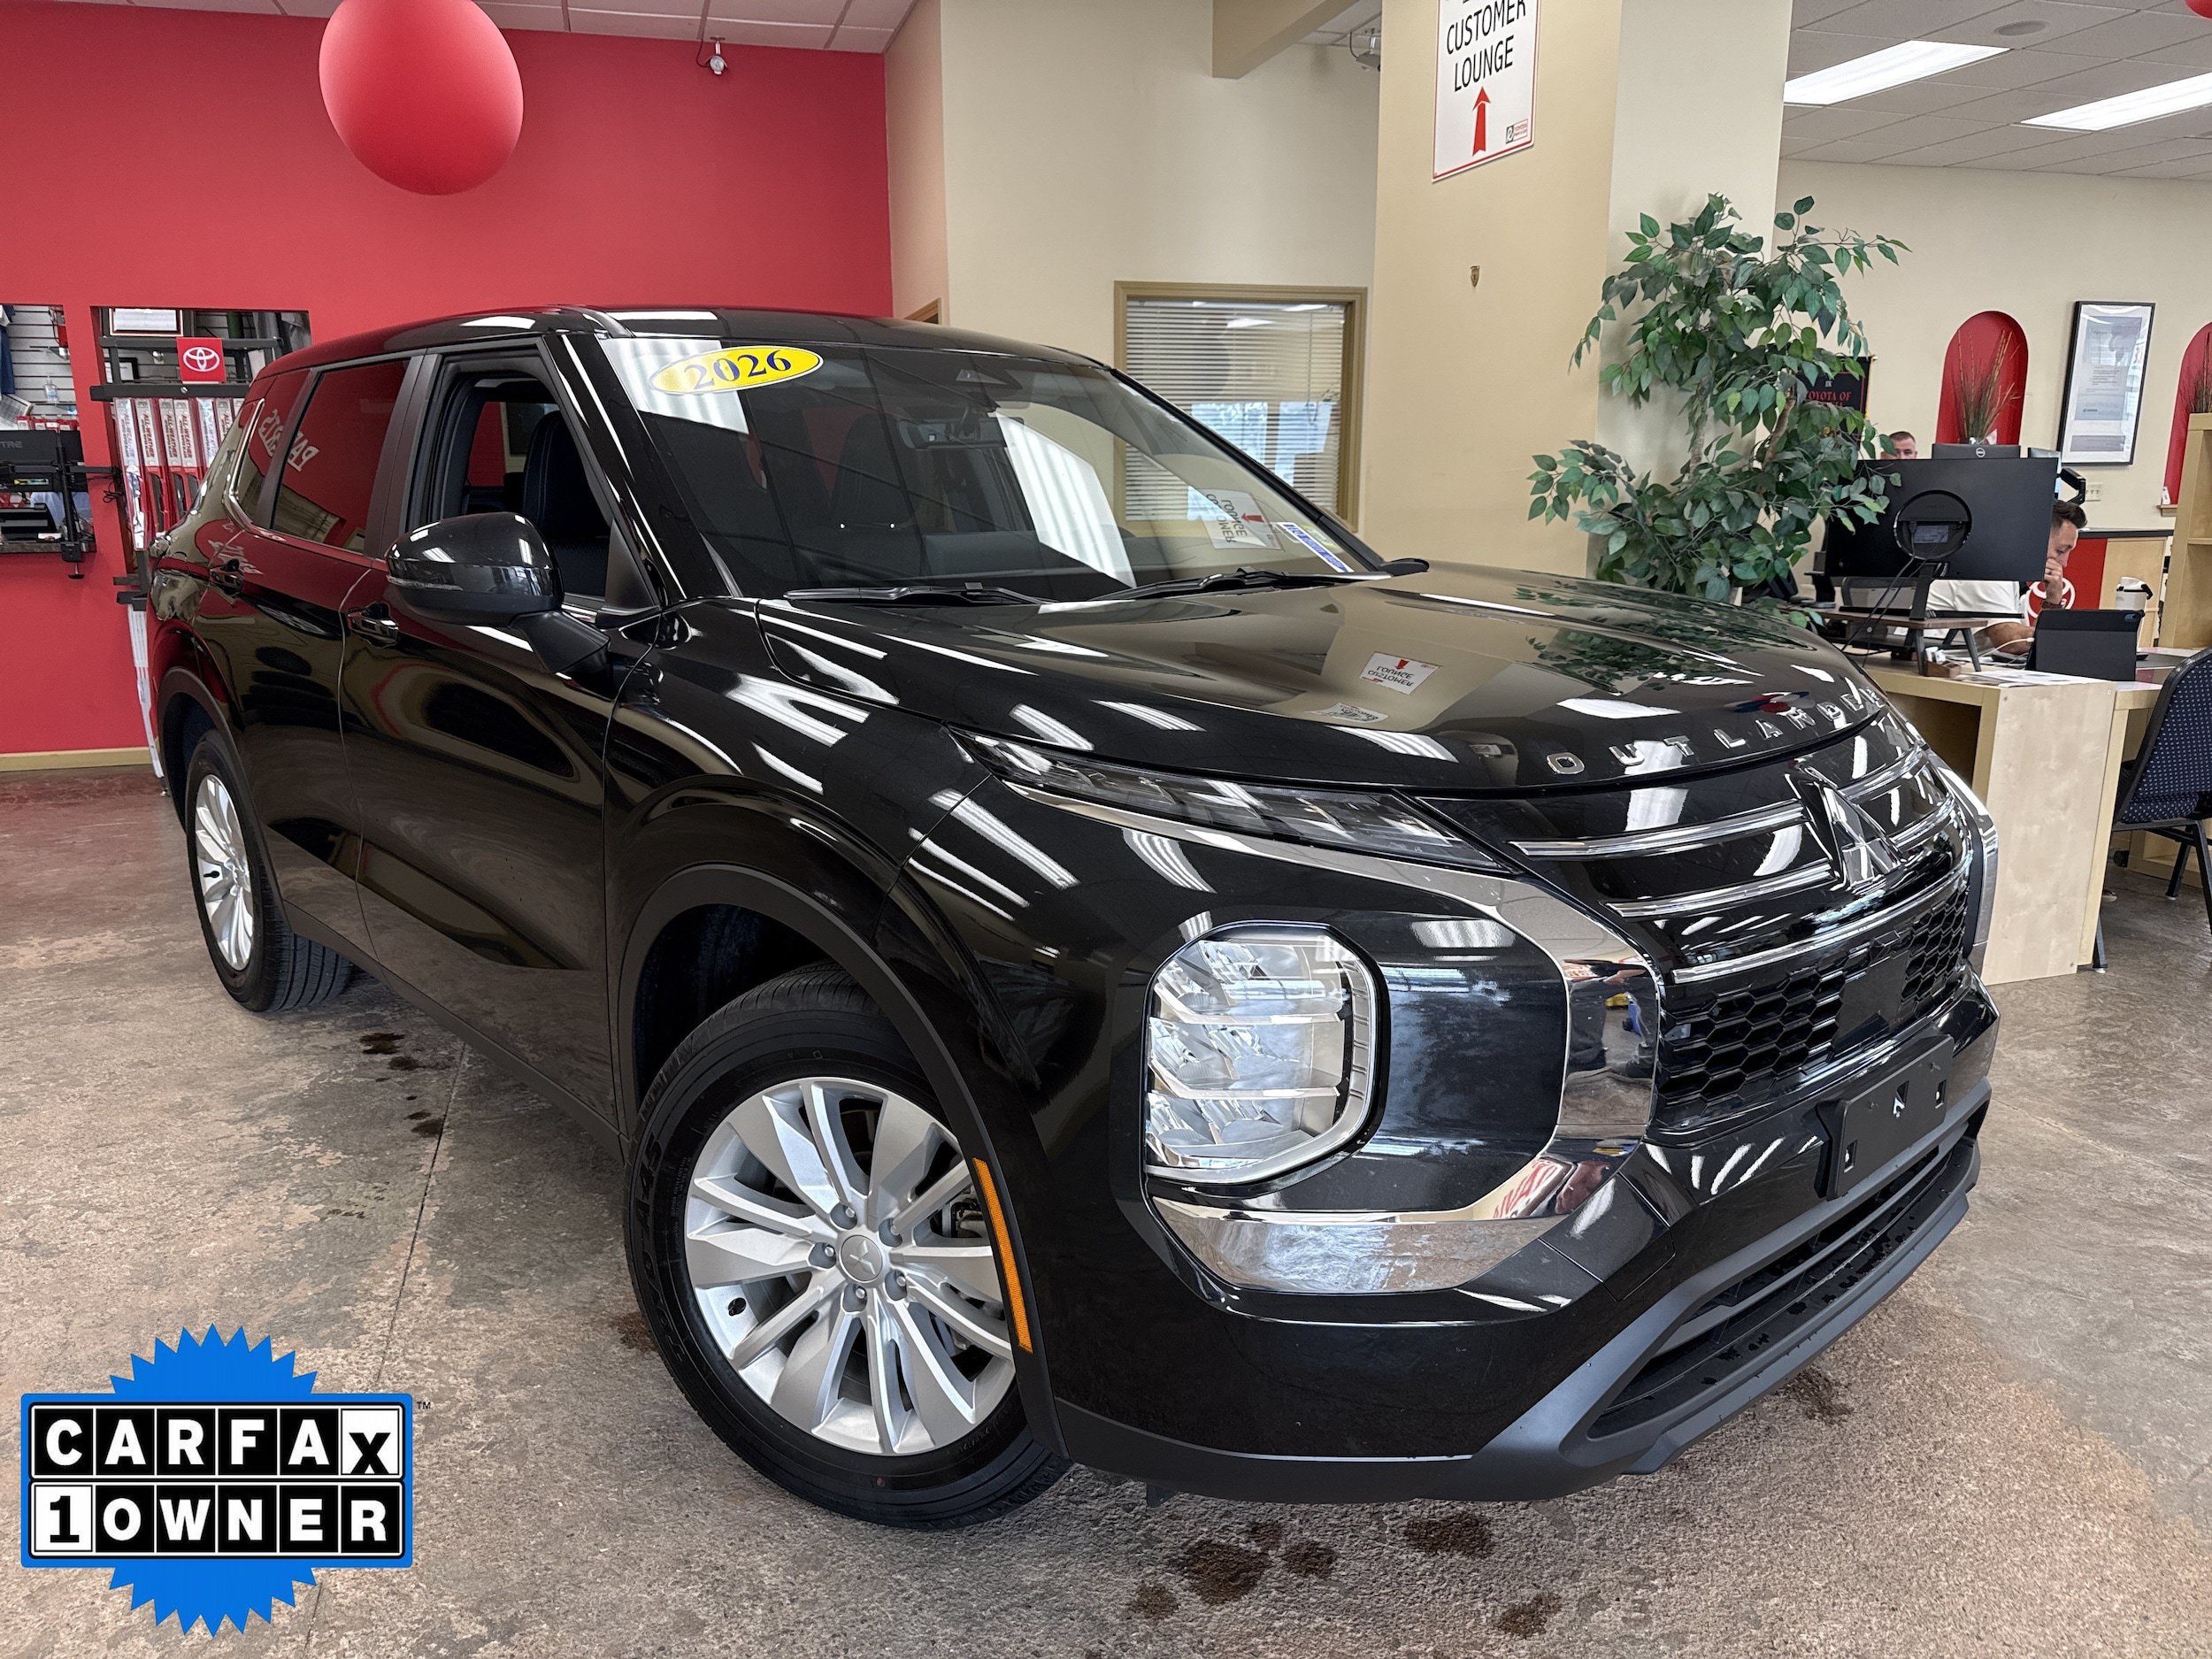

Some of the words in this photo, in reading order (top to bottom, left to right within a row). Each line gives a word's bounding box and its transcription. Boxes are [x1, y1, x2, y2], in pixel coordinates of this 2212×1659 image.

[1447, 0, 1526, 55] CUSTOMER
[1454, 35, 1515, 92] LOUNGE
[683, 349, 792, 390] 2026
[1807, 390, 1837, 402] OYOTA
[1839, 391, 1852, 402] OF
[142, 413, 155, 457] ALL-WEATHER
[165, 413, 178, 457] ALL-WEATHER
[181, 414, 193, 458] ALL-WEATHER
[1547, 687, 1886, 775] OUTLANDER
